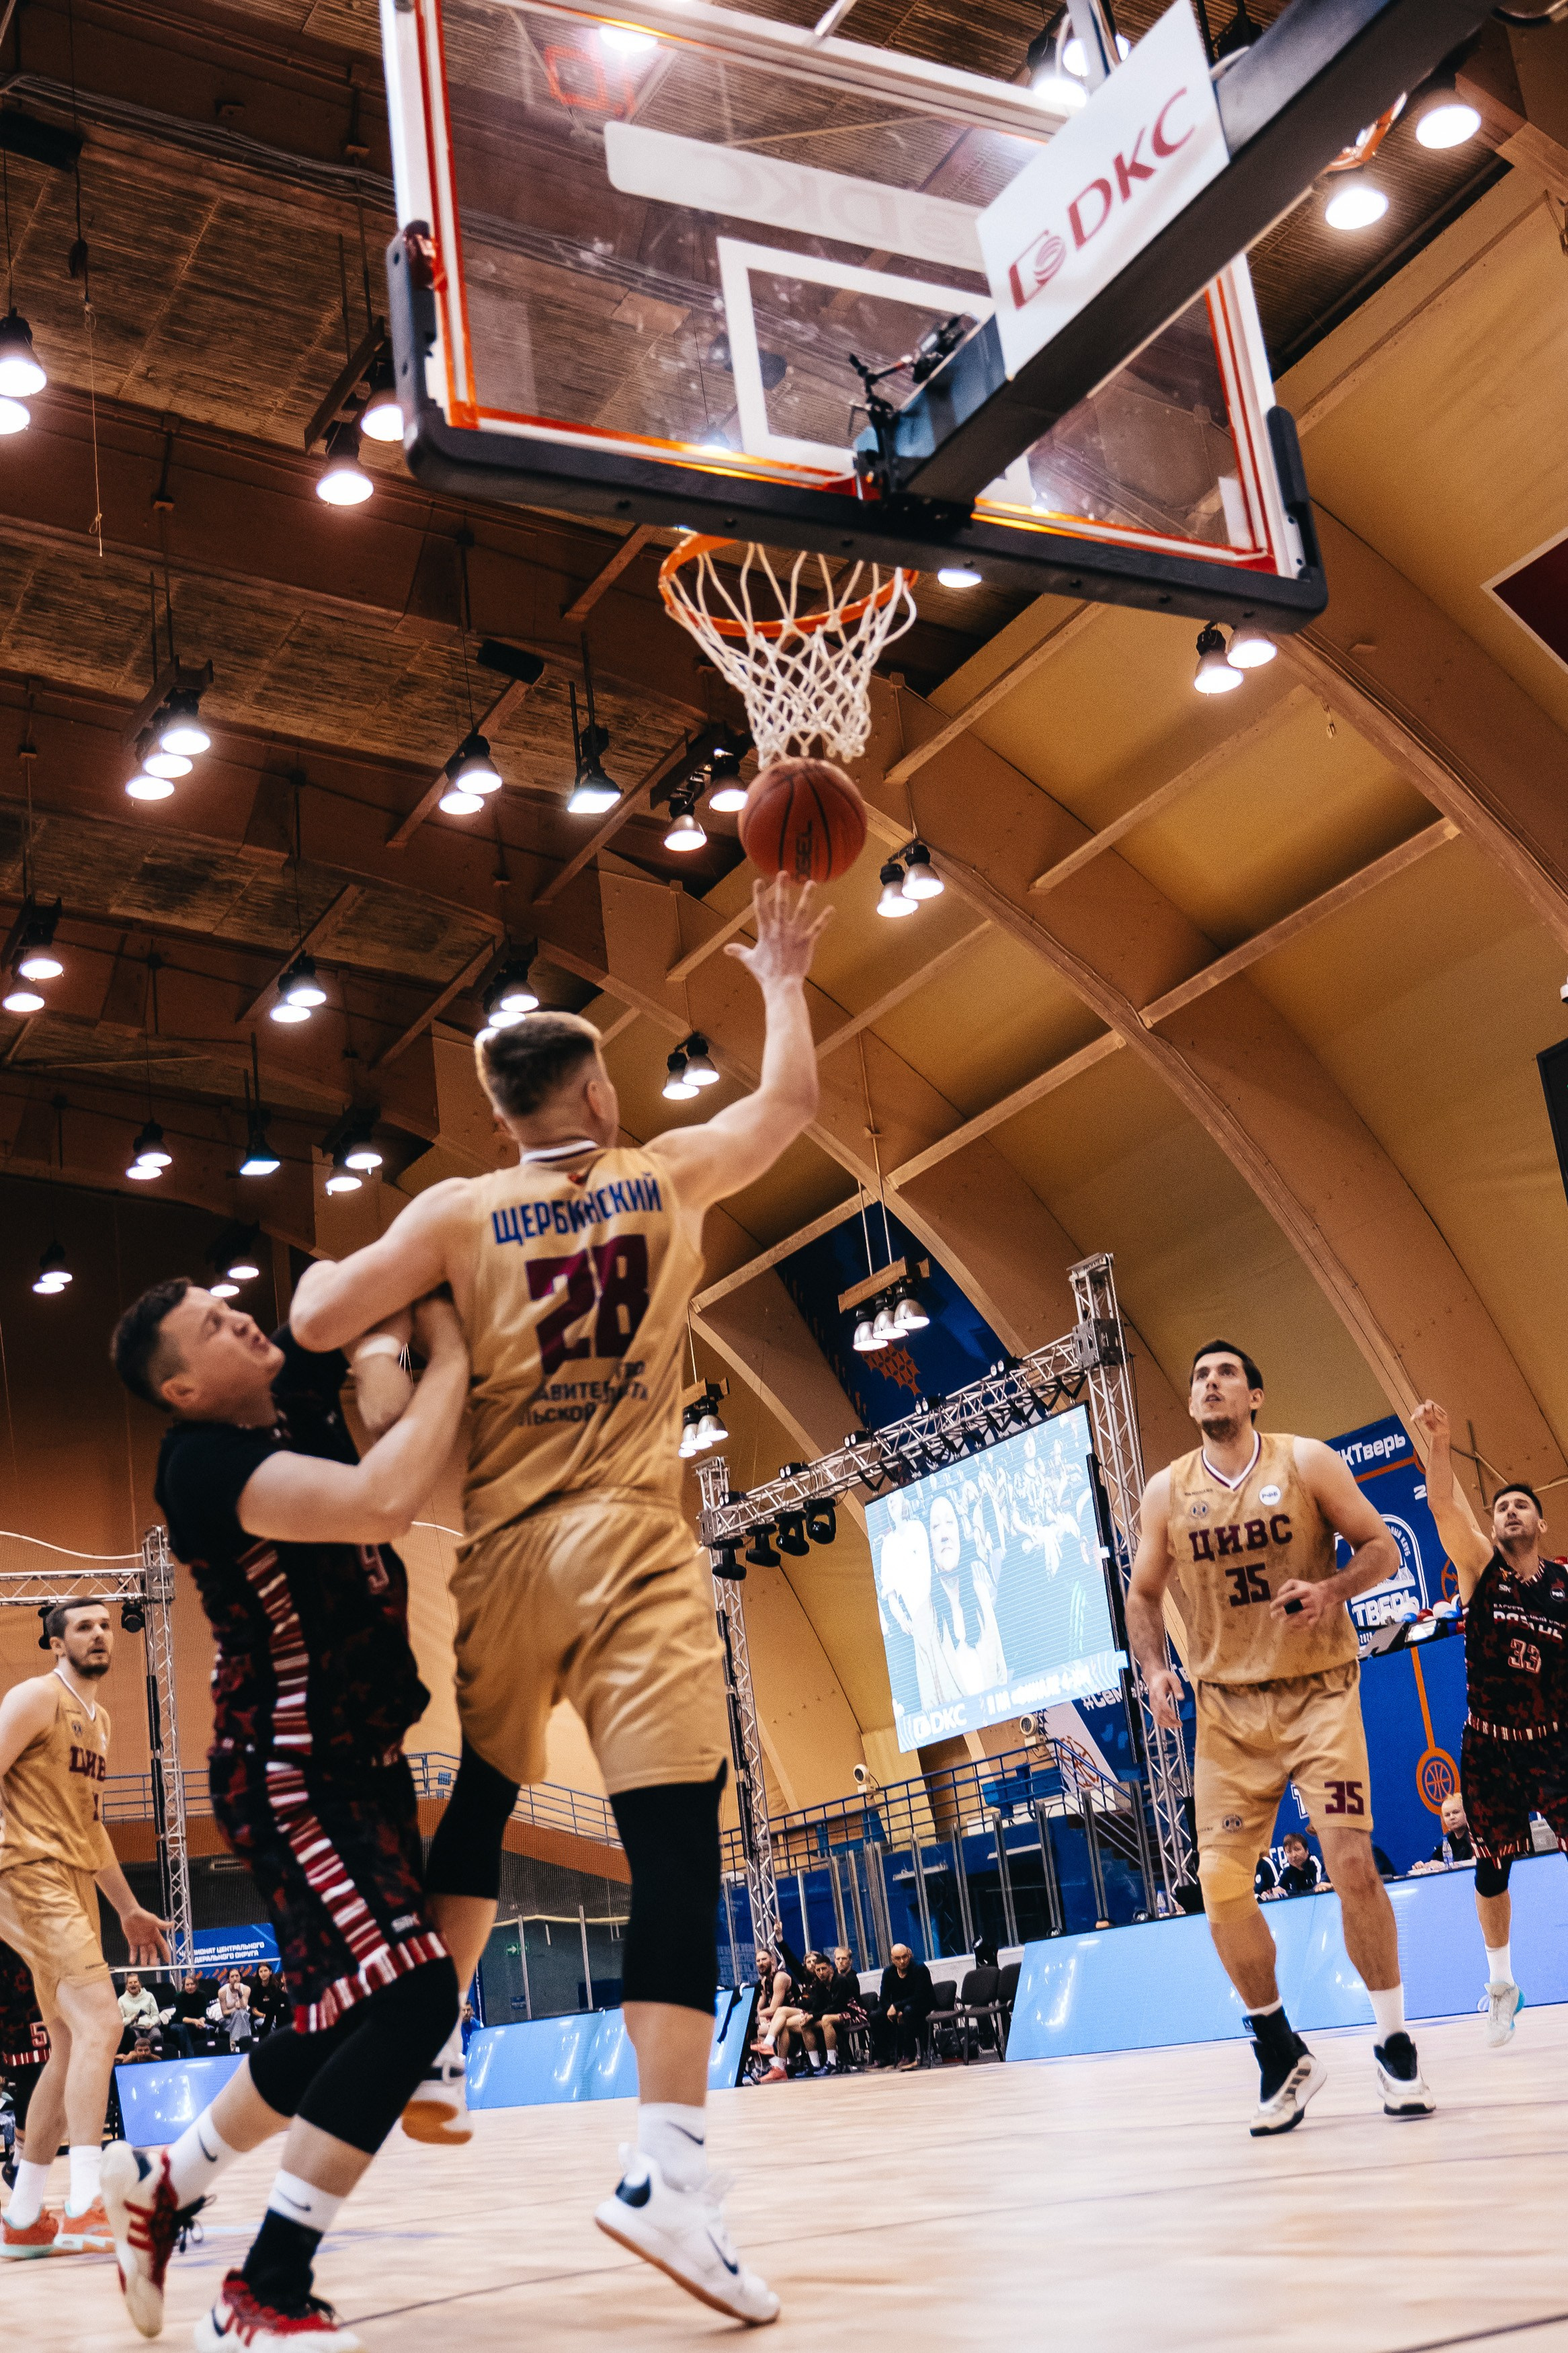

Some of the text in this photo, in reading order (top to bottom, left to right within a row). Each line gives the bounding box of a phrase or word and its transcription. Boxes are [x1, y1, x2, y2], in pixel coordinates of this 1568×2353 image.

[1067, 86, 1196, 250] DKC
[524, 1234, 651, 1376] 28
[1337, 1433, 1406, 1466] КТверь
[1189, 1514, 1292, 1562] ЦИВС
[1225, 1562, 1272, 1607] 35
[1508, 1638, 1542, 1674] 33
[931, 1703, 968, 1731] DKC
[1324, 1782, 1364, 1815] 35
[194, 1952, 235, 1964] ДЕРАЛЬНОГО
